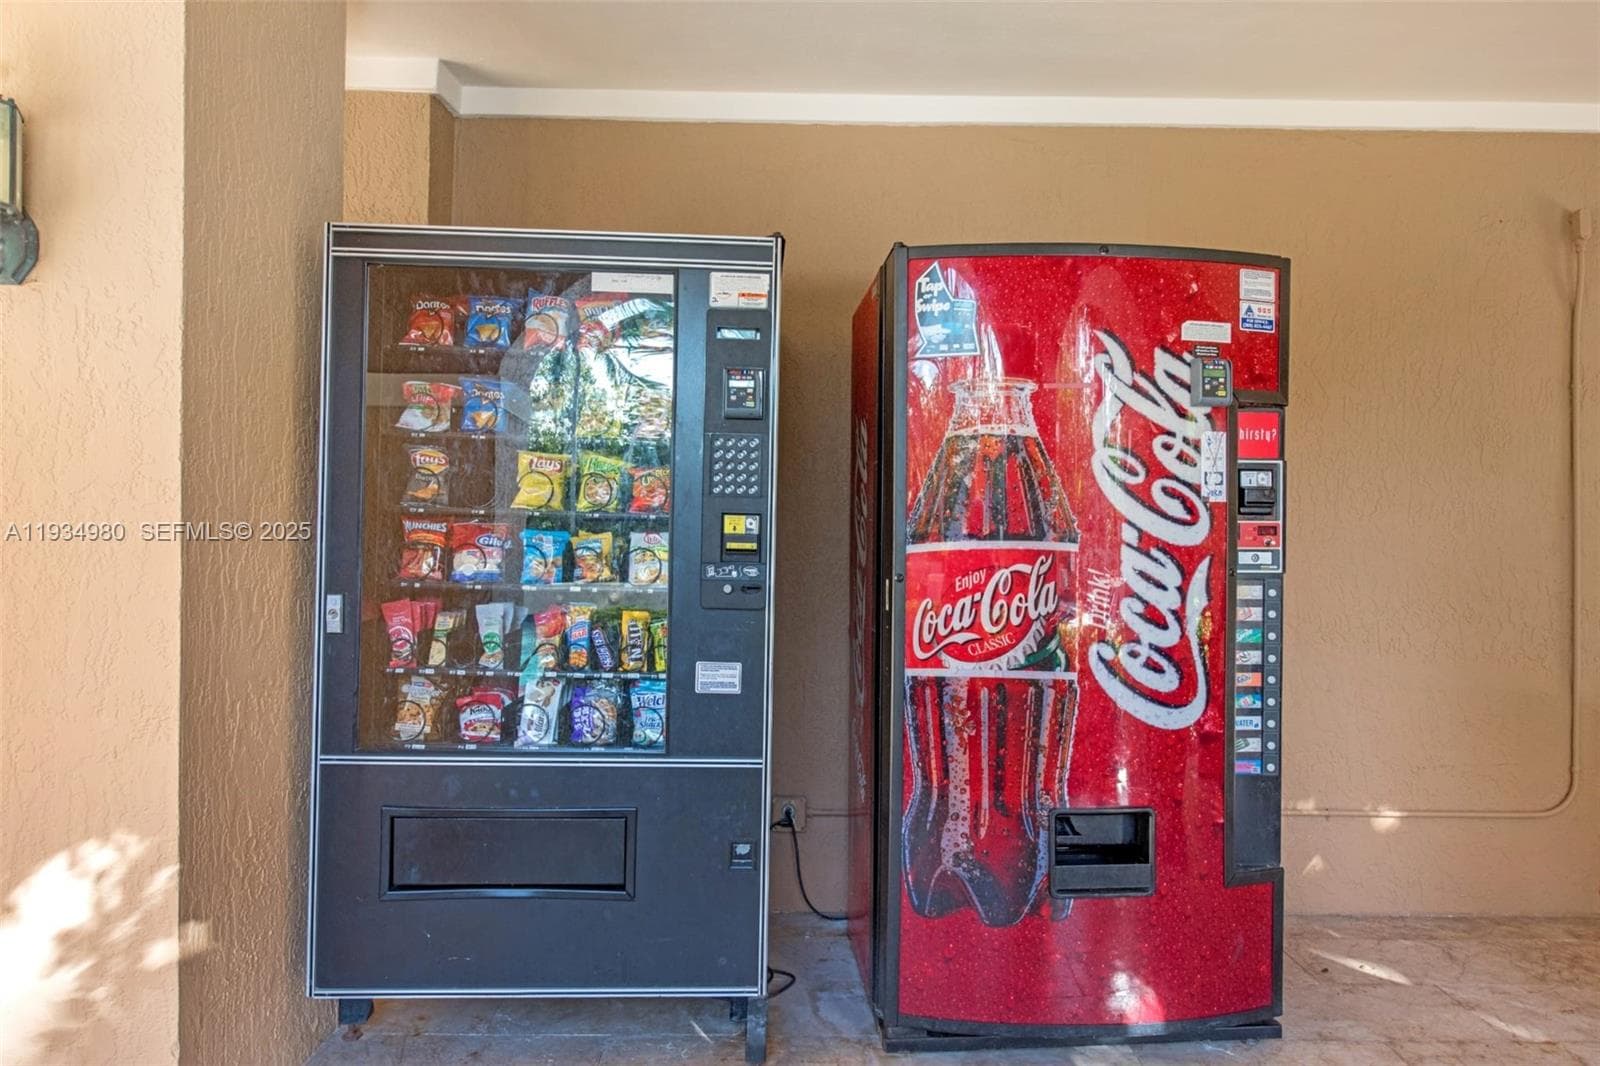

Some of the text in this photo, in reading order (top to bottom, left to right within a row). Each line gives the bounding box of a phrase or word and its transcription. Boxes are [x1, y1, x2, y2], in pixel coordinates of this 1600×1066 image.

[920, 276, 944, 297] Tap
[917, 298, 951, 317] Swipe
[1088, 328, 1213, 730] Coca-Cola
[955, 569, 987, 592] Enjoy
[913, 552, 1059, 660] Coca-Cola
[968, 631, 1016, 657] CLASSIC
